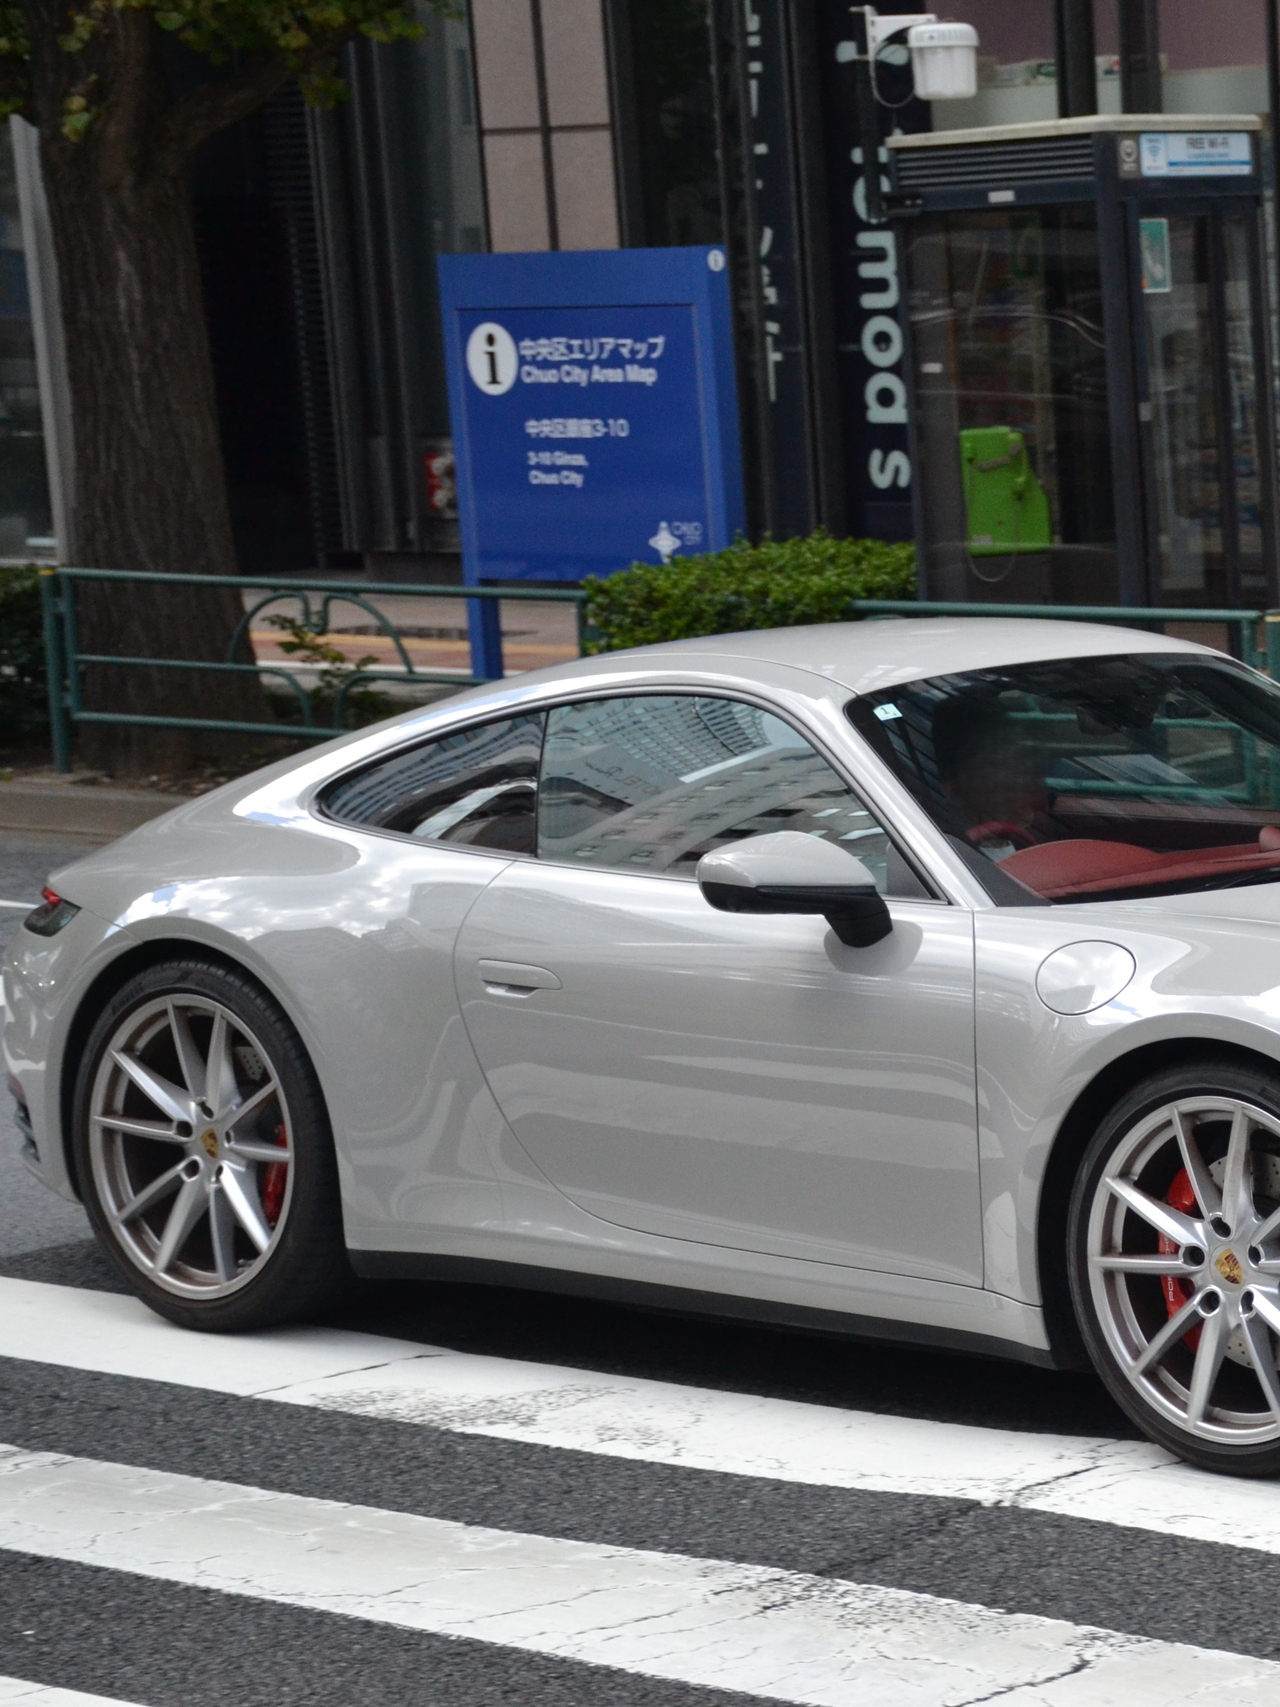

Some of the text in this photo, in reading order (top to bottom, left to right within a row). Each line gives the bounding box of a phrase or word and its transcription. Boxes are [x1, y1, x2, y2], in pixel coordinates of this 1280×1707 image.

[519, 335, 665, 361] 中央区エリアマップ
[520, 364, 658, 387] Chuo City Area Map
[528, 470, 584, 488] Chuo City
